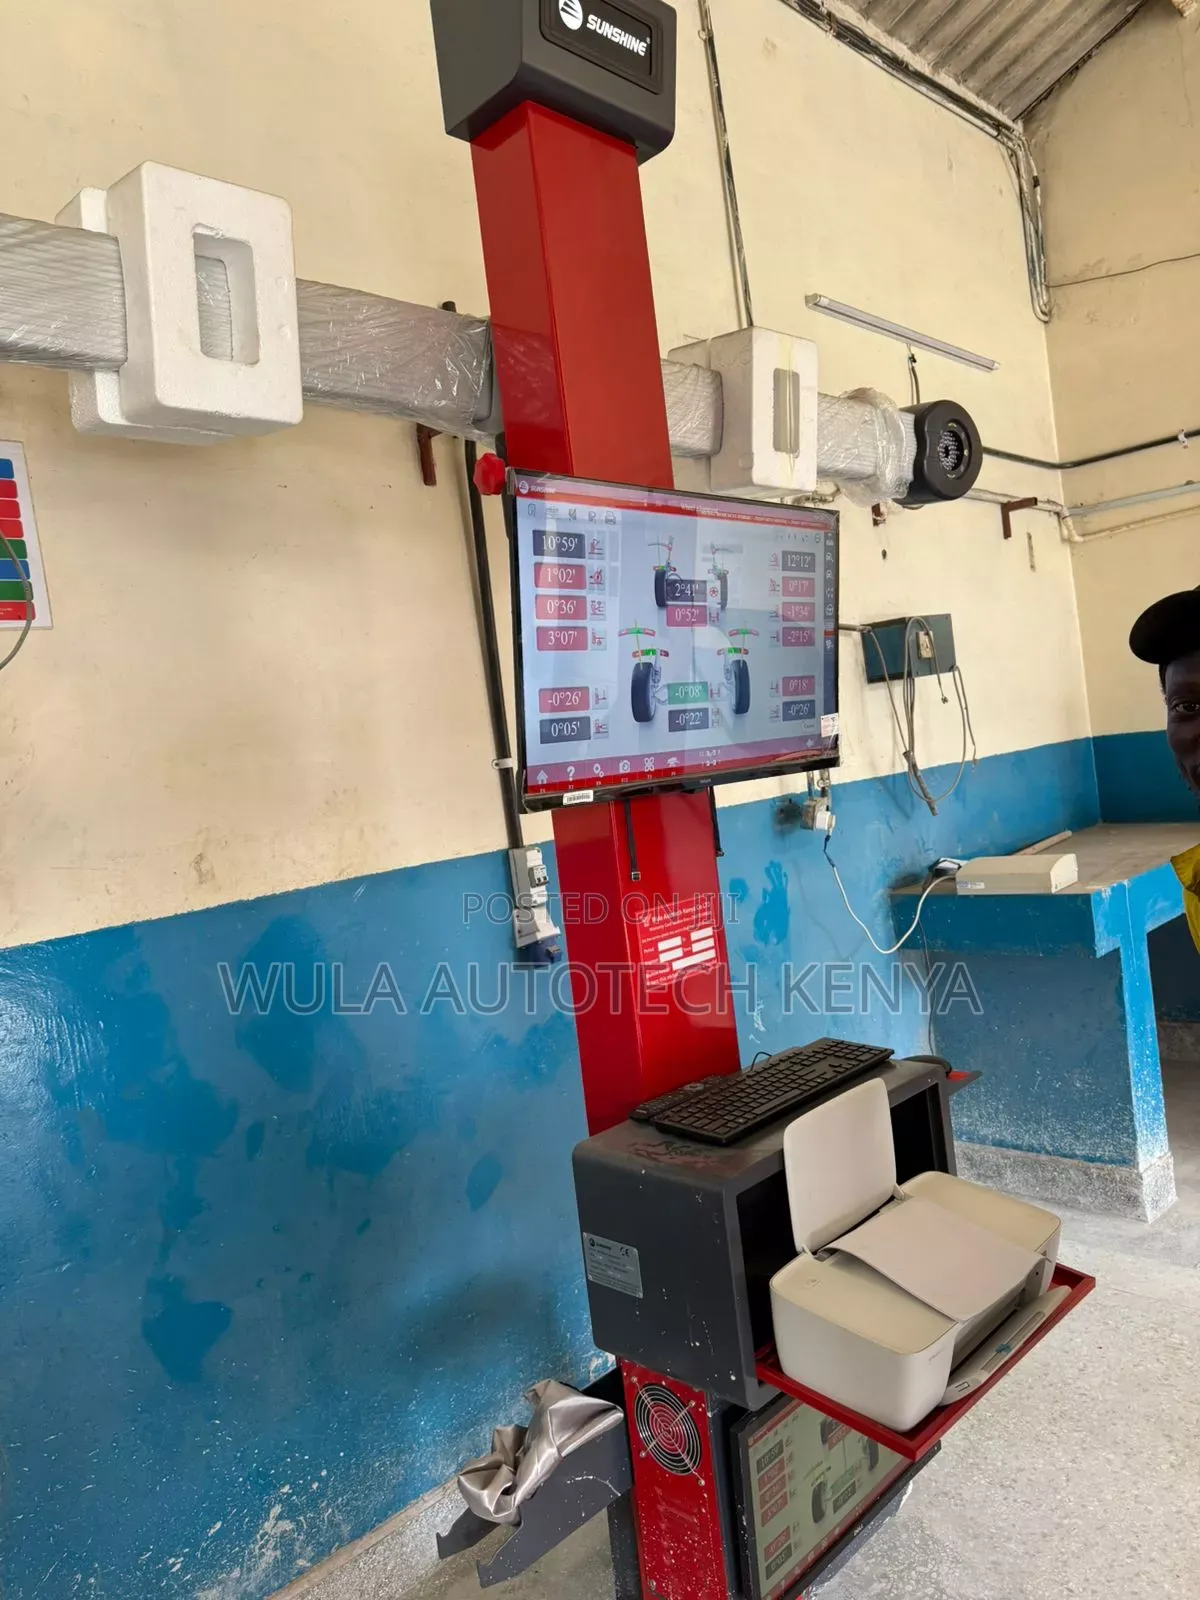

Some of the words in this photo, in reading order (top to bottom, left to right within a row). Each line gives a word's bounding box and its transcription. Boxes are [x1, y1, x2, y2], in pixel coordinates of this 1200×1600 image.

[586, 14, 648, 57] SUNSHINE
[541, 534, 578, 552] 10°59'
[546, 568, 576, 584] 1°02'
[674, 584, 700, 598] 2°41'
[547, 599, 577, 615] 0°36'
[675, 608, 700, 622] 0°52'
[547, 631, 578, 647] 3°07'
[547, 691, 582, 707] -0°26'
[551, 721, 581, 737] 0°05'
